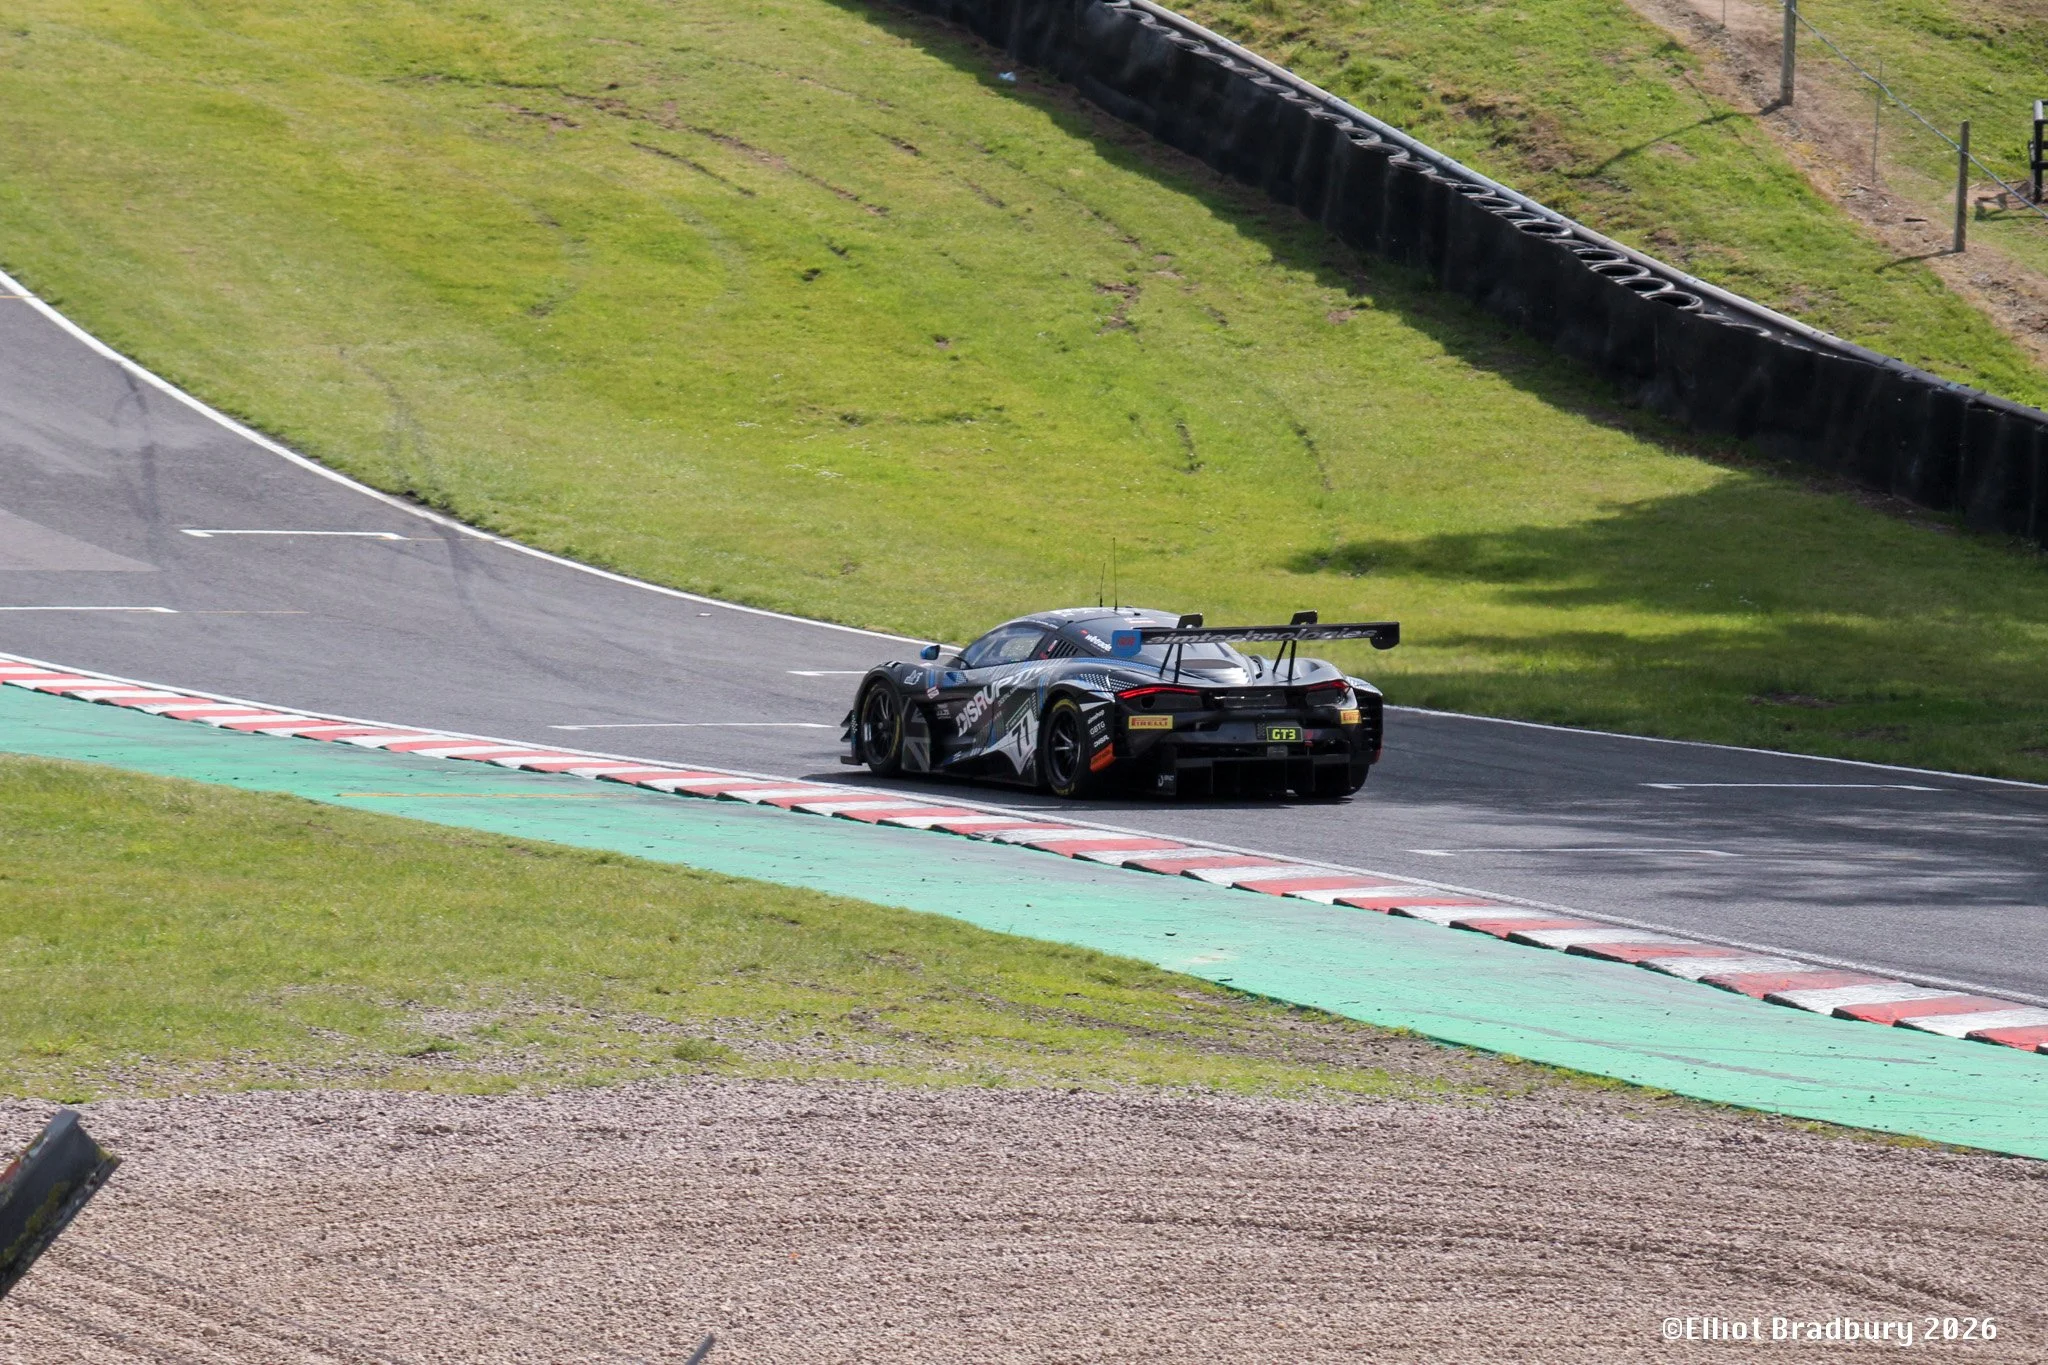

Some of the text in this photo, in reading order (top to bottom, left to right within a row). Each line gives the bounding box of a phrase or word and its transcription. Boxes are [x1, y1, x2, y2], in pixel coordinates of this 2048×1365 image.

[1131, 717, 1168, 727] PIRELLI
[1012, 715, 1030, 758] 71
[1272, 728, 1296, 740] GT3
